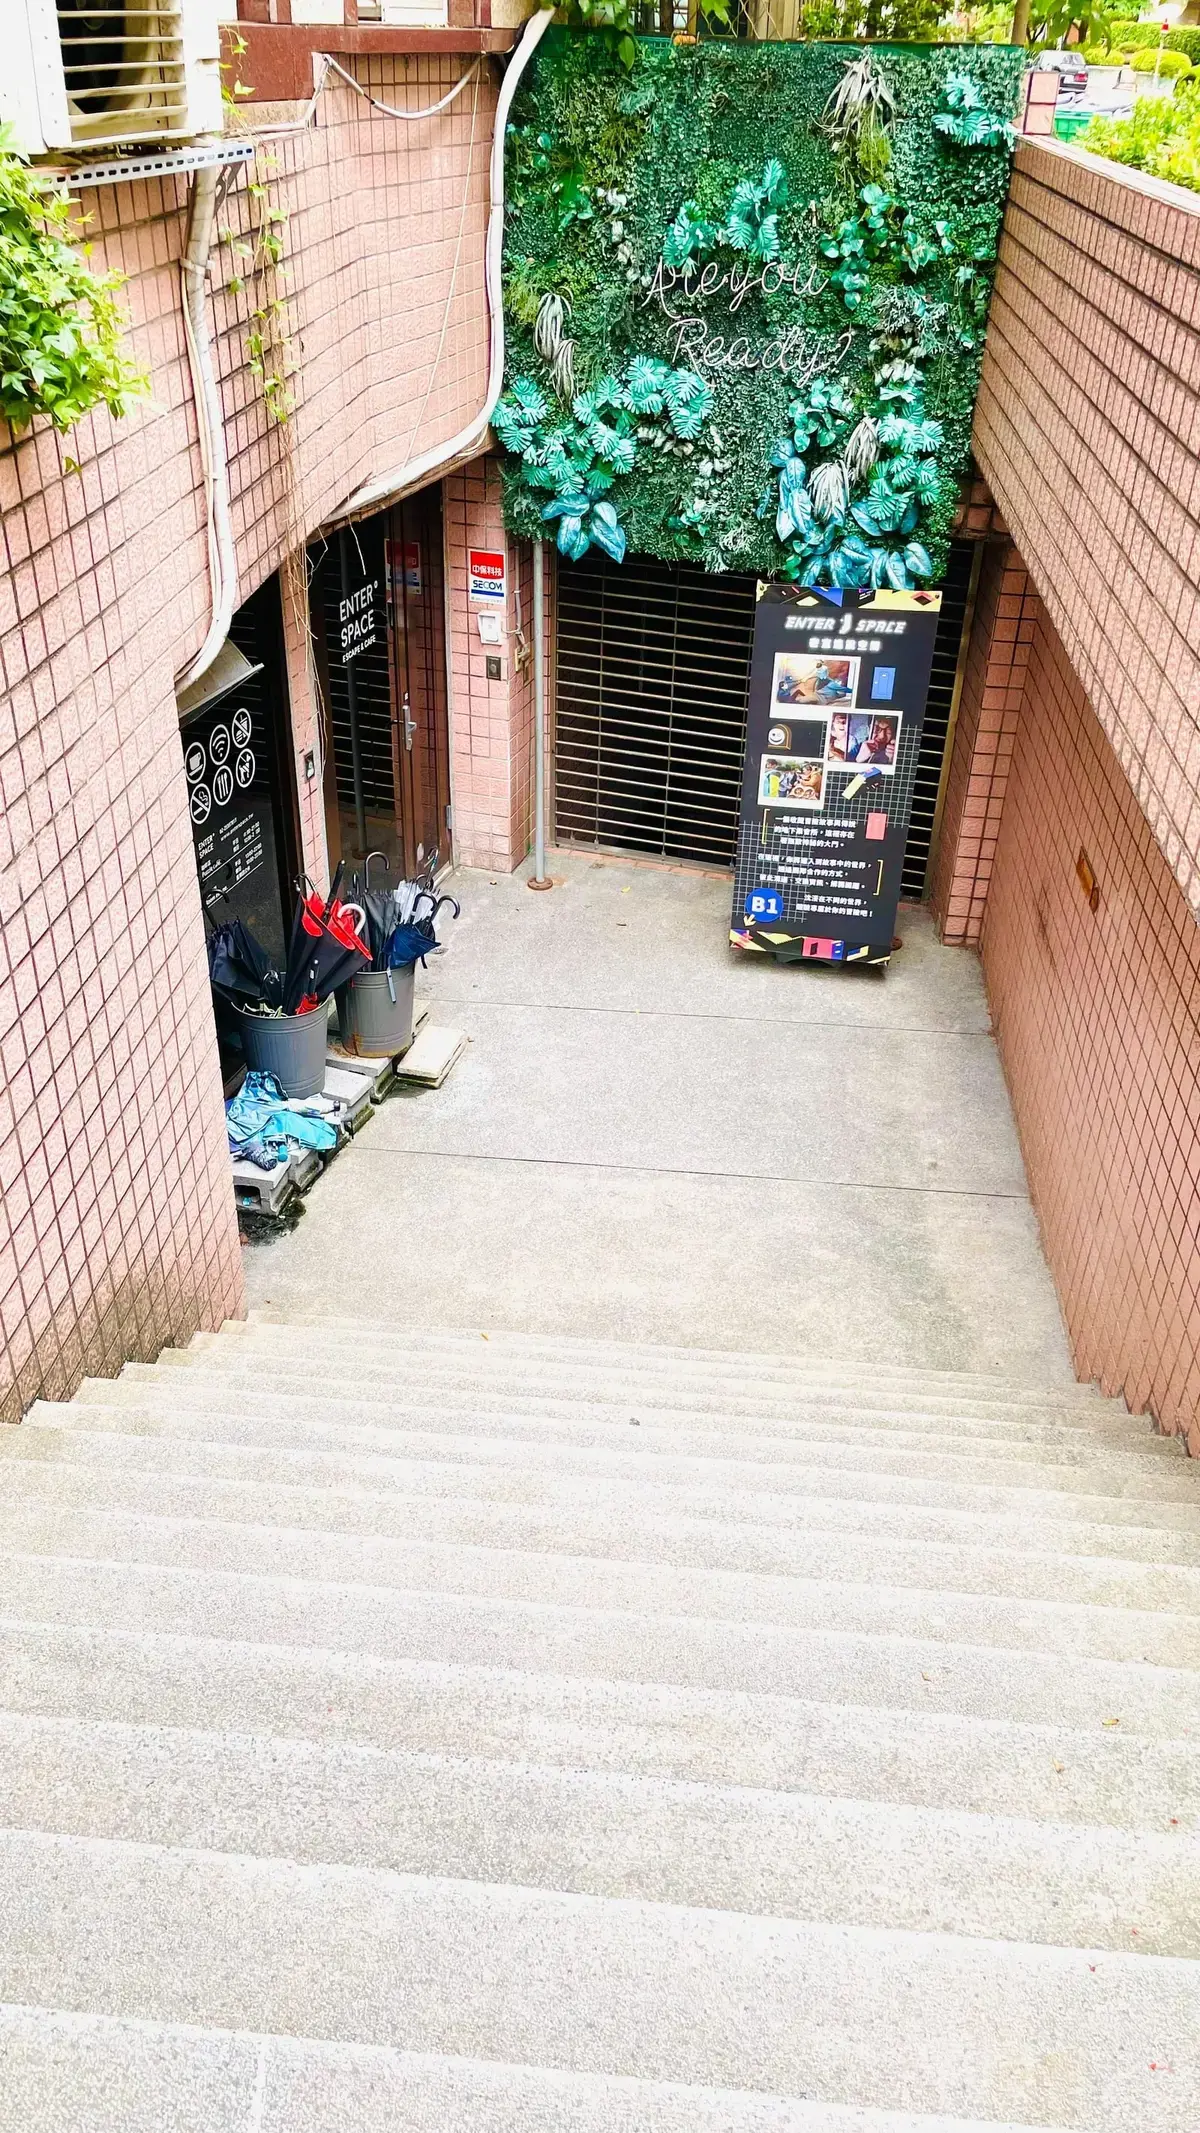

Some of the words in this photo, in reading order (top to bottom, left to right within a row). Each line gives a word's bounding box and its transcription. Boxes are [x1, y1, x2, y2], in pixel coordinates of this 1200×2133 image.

[472, 564, 502, 577] 中保科技
[473, 579, 502, 591] SECOM
[341, 609, 375, 648] SPACE
[784, 615, 836, 630] ENTER
[855, 619, 907, 634] SPACE
[342, 644, 360, 663] ESCAPE
[199, 842, 214, 859] SPACE
[751, 896, 779, 915] B1
